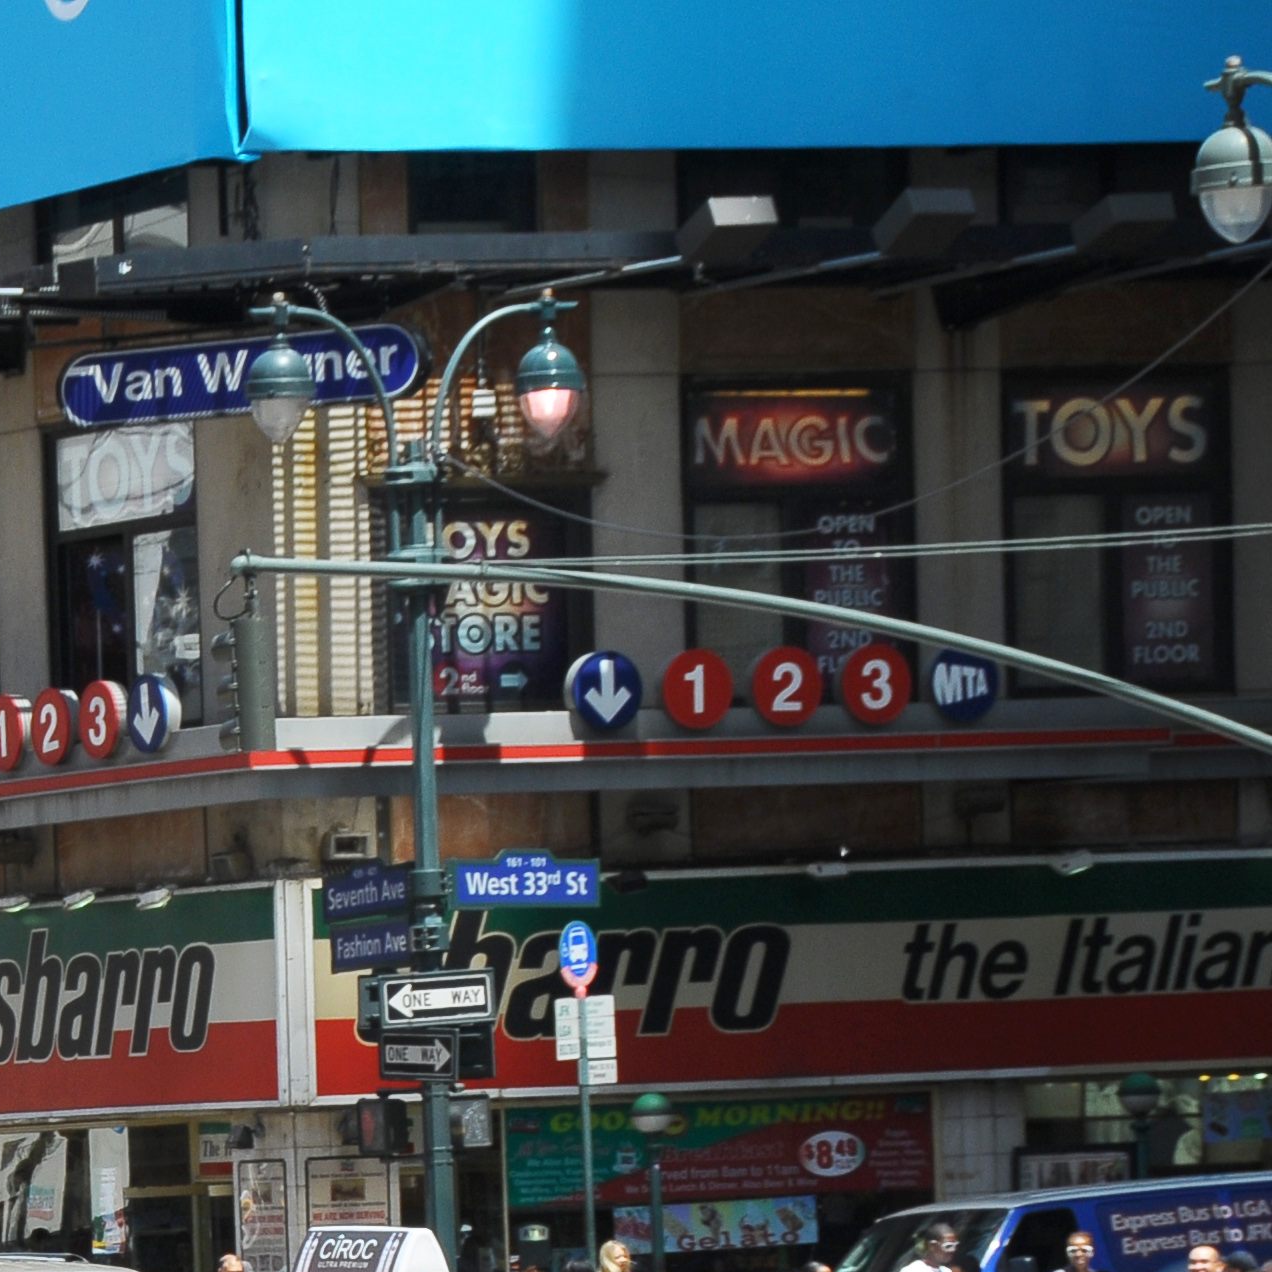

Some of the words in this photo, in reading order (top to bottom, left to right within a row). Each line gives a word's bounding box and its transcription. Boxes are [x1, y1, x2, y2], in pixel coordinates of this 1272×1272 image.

[93, 362, 183, 403] Van
[197, 343, 398, 403] Wner
[693, 414, 890, 467] MAGIC
[1012, 394, 1207, 467] TOYS
[60, 430, 194, 526] TOYS
[817, 515, 876, 535] OPEN
[1135, 505, 1192, 526] OPEN
[426, 520, 532, 560] OYS
[829, 565, 865, 584] THE
[1132, 644, 1199, 665] FLOOR
[684, 664, 705, 713] 1
[771, 662, 803, 711] 2
[861, 659, 893, 710] 3
[932, 663, 989, 705] MTA
[40, 703, 60, 754] 2
[88, 696, 106, 746] 3
[327, 885, 378, 911] Seventh
[381, 880, 406, 902] Ave
[465, 871, 519, 896] West
[522, 869, 561, 896] 33rd
[565, 871, 588, 896] St
[336, 937, 384, 960] Fashion
[386, 933, 407, 954] Ave
[902, 922, 1048, 1003] the
[354, 908, 794, 1047] barro
[402, 992, 432, 1009] ONE
[451, 988, 481, 1005] WAY
[387, 1043, 409, 1062] ONE
[420, 1044, 443, 1063] WAY
[1110, 1211, 1176, 1232] Express
[1178, 1206, 1210, 1223] Bus
[1213, 1203, 1232, 1219] to
[1235, 1199, 1272, 1219] LGA
[675, 1222, 801, 1253] Gelato
[1121, 1233, 1187, 1256] Express
[1189, 1229, 1220, 1247] Bus
[1223, 1227, 1243, 1243] to
